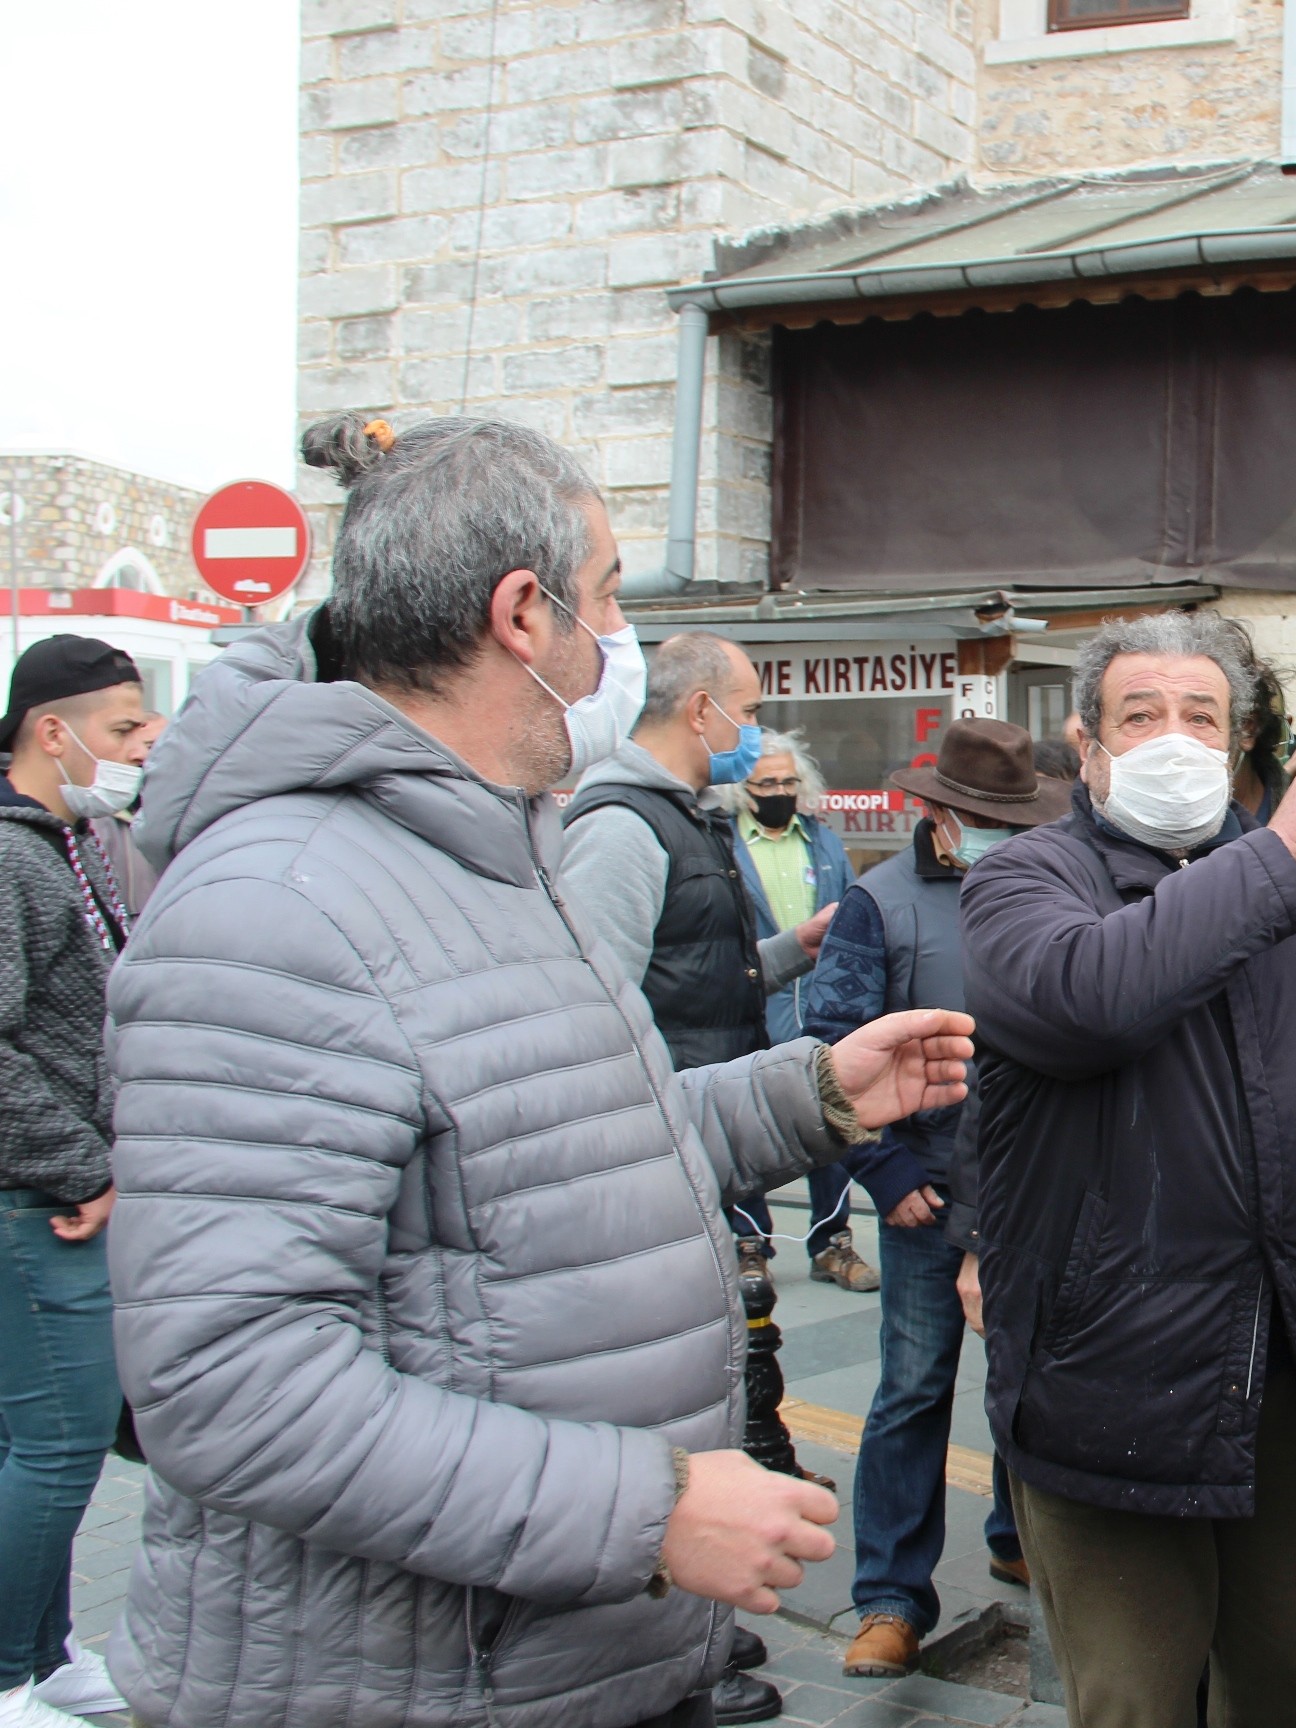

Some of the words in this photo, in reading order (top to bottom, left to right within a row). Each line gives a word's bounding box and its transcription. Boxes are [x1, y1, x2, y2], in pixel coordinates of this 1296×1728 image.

[752, 660, 791, 695] ME
[805, 645, 956, 695] KIRTASİYE
[806, 791, 890, 810] OTOKOPİ
[844, 811, 917, 832] KIRT
